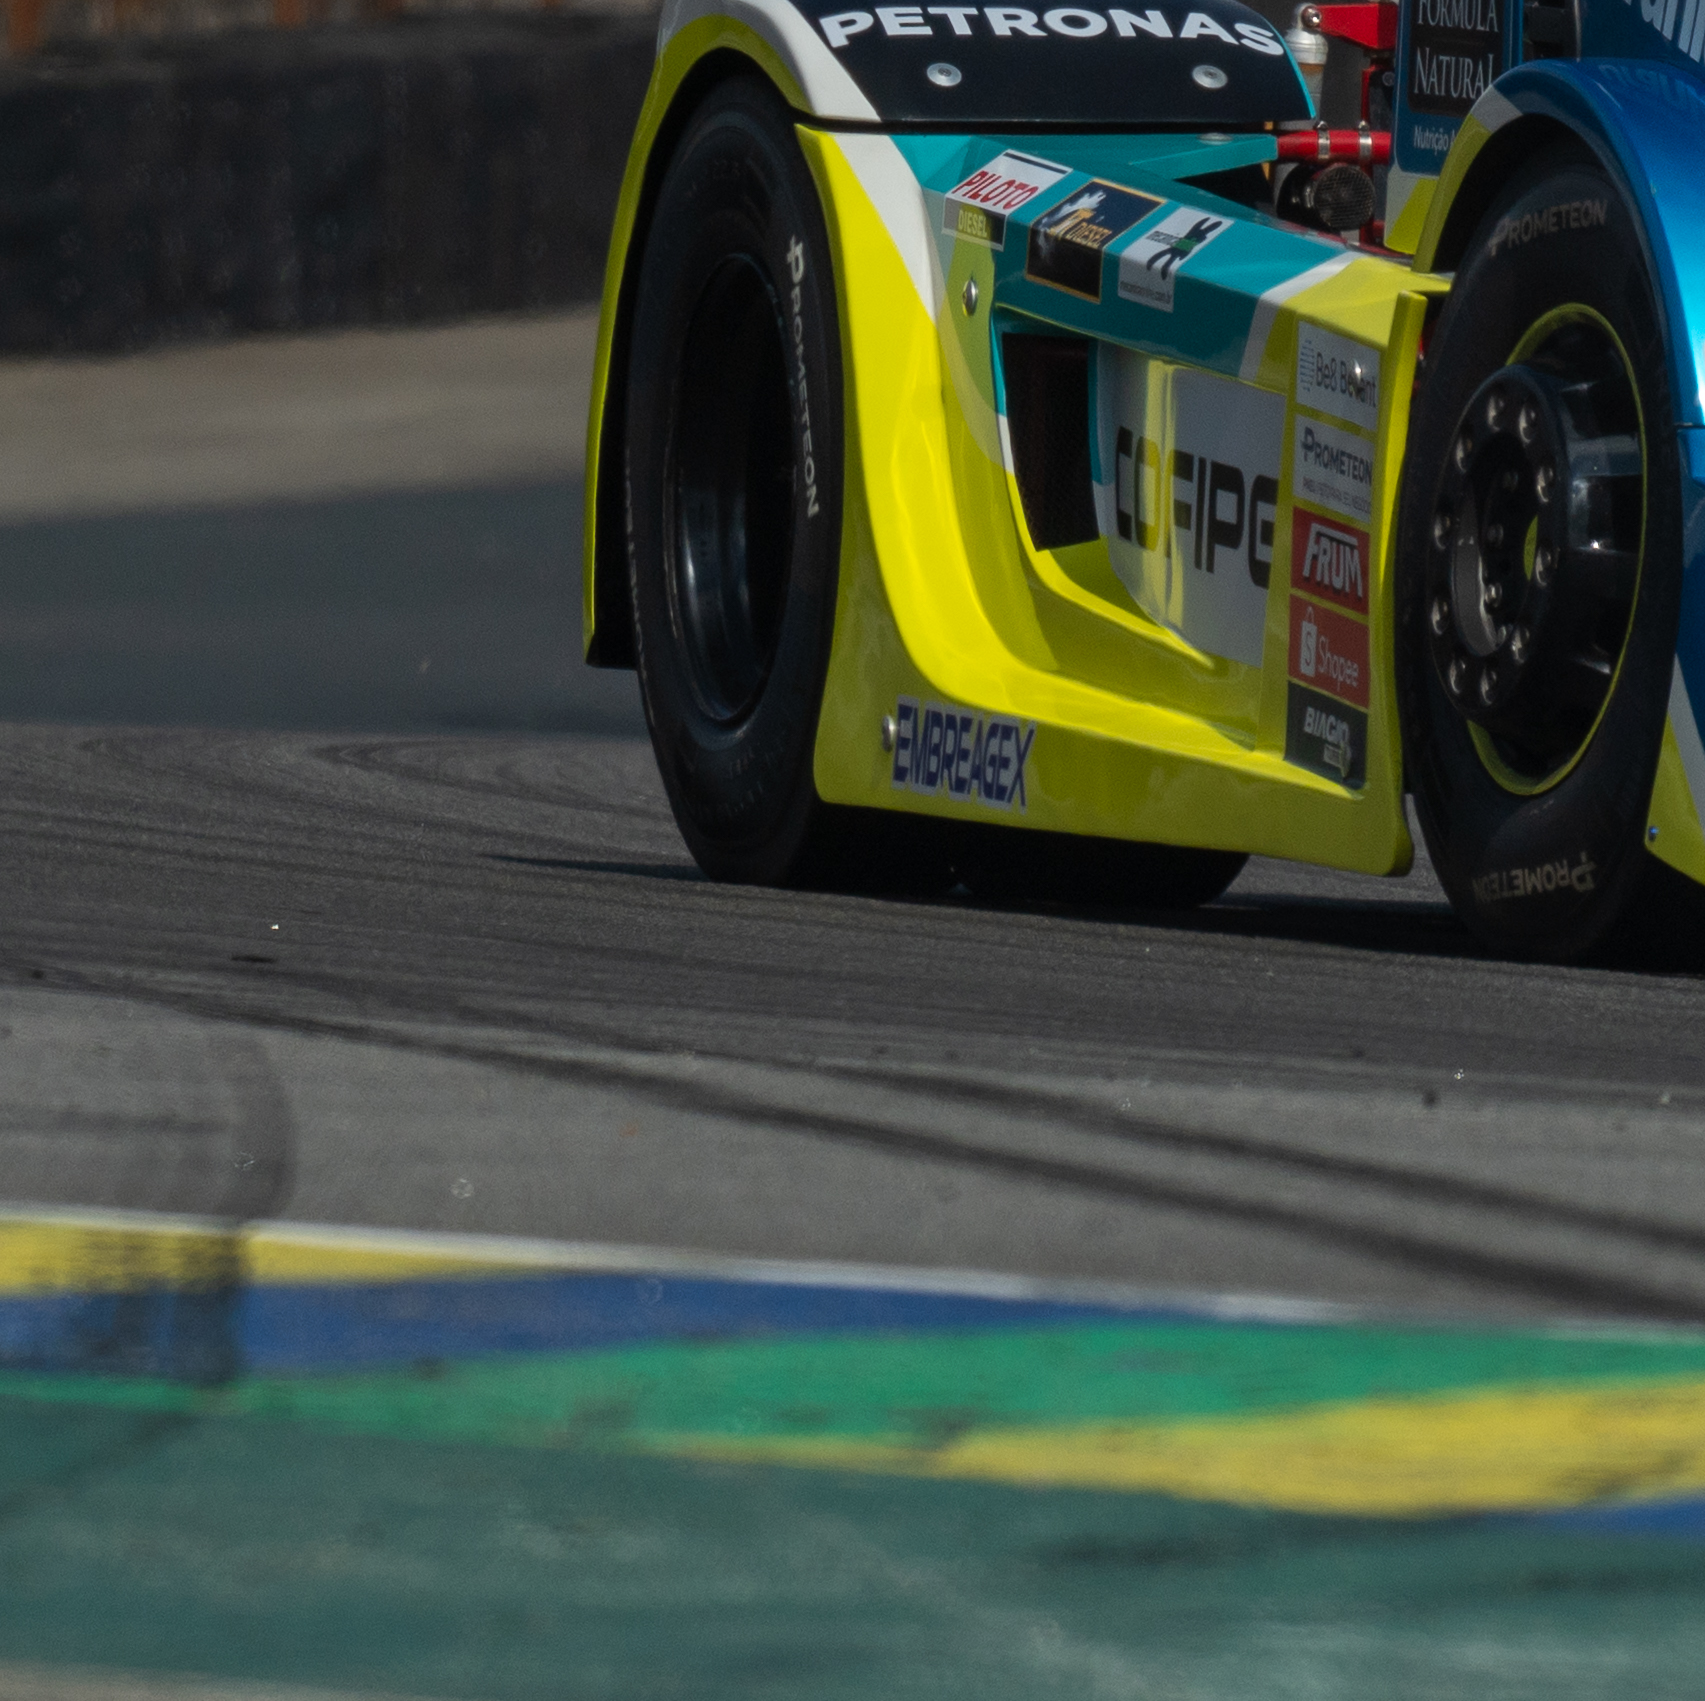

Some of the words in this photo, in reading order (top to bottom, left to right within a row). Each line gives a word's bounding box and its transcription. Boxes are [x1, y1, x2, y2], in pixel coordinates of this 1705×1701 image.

[817, 5, 1284, 56] PETRONAS
[1413, 47, 1495, 99] NATURAL
[1413, 124, 1450, 155] Nutrição
[951, 170, 1040, 211] PILOTO
[957, 209, 989, 239] DIESEL
[1066, 222, 1113, 249] DIESEL
[1487, 199, 1609, 258] PROMETEON
[785, 235, 821, 518] PROMETEON
[1302, 426, 1373, 486] PROMETEON
[1302, 522, 1363, 598] FRUM
[1317, 633, 1360, 692] Shopee
[892, 702, 1035, 808] EMBREAGEX
